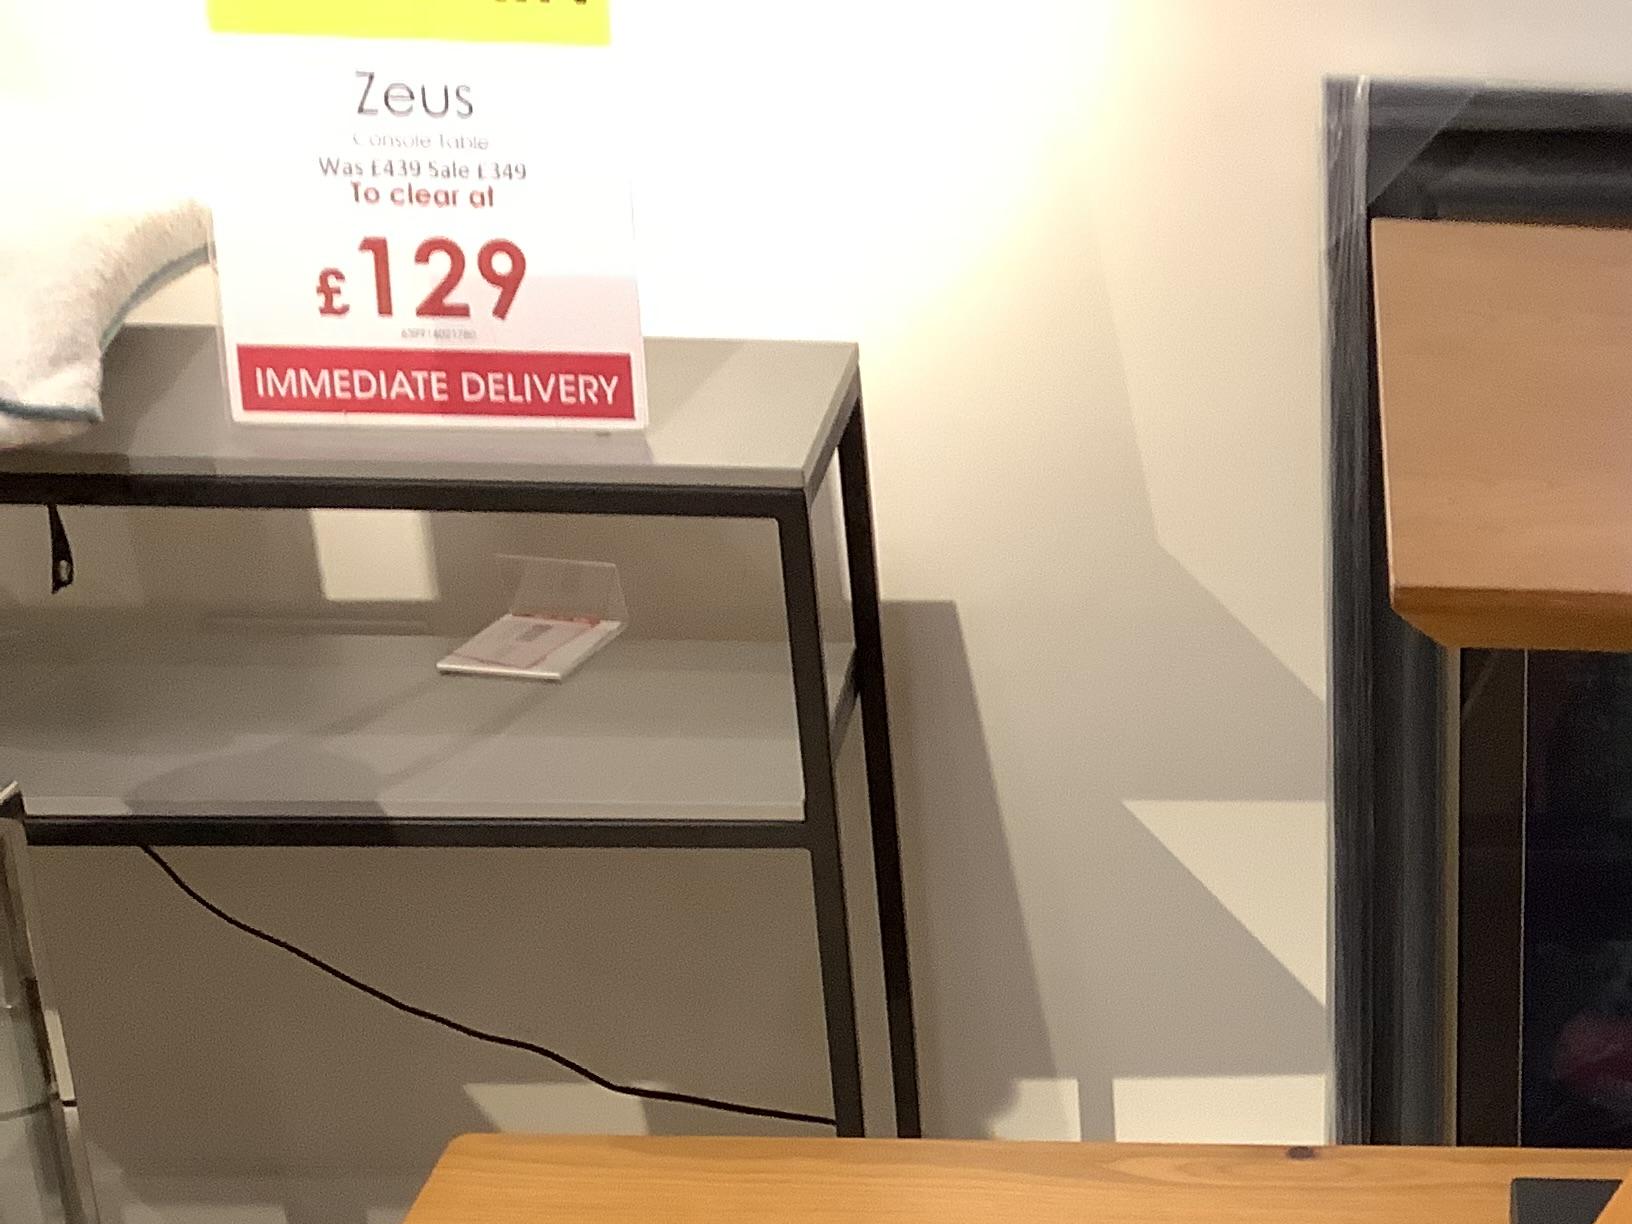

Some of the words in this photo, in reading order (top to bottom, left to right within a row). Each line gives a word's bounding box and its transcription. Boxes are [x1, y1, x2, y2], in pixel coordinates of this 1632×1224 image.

[355, 70, 474, 119] Zeus
[353, 132, 431, 149] Console
[439, 134, 489, 150] Table
[318, 157, 363, 177] Was
[371, 160, 421, 178] £439
[429, 160, 470, 179] Sale
[478, 162, 527, 180] £349
[351, 181, 380, 205] To
[390, 182, 459, 208] clear
[469, 184, 494, 208] at
[316, 235, 527, 321] £129
[255, 366, 449, 401] IMMEDIATE
[461, 372, 619, 405] DELIVERY
